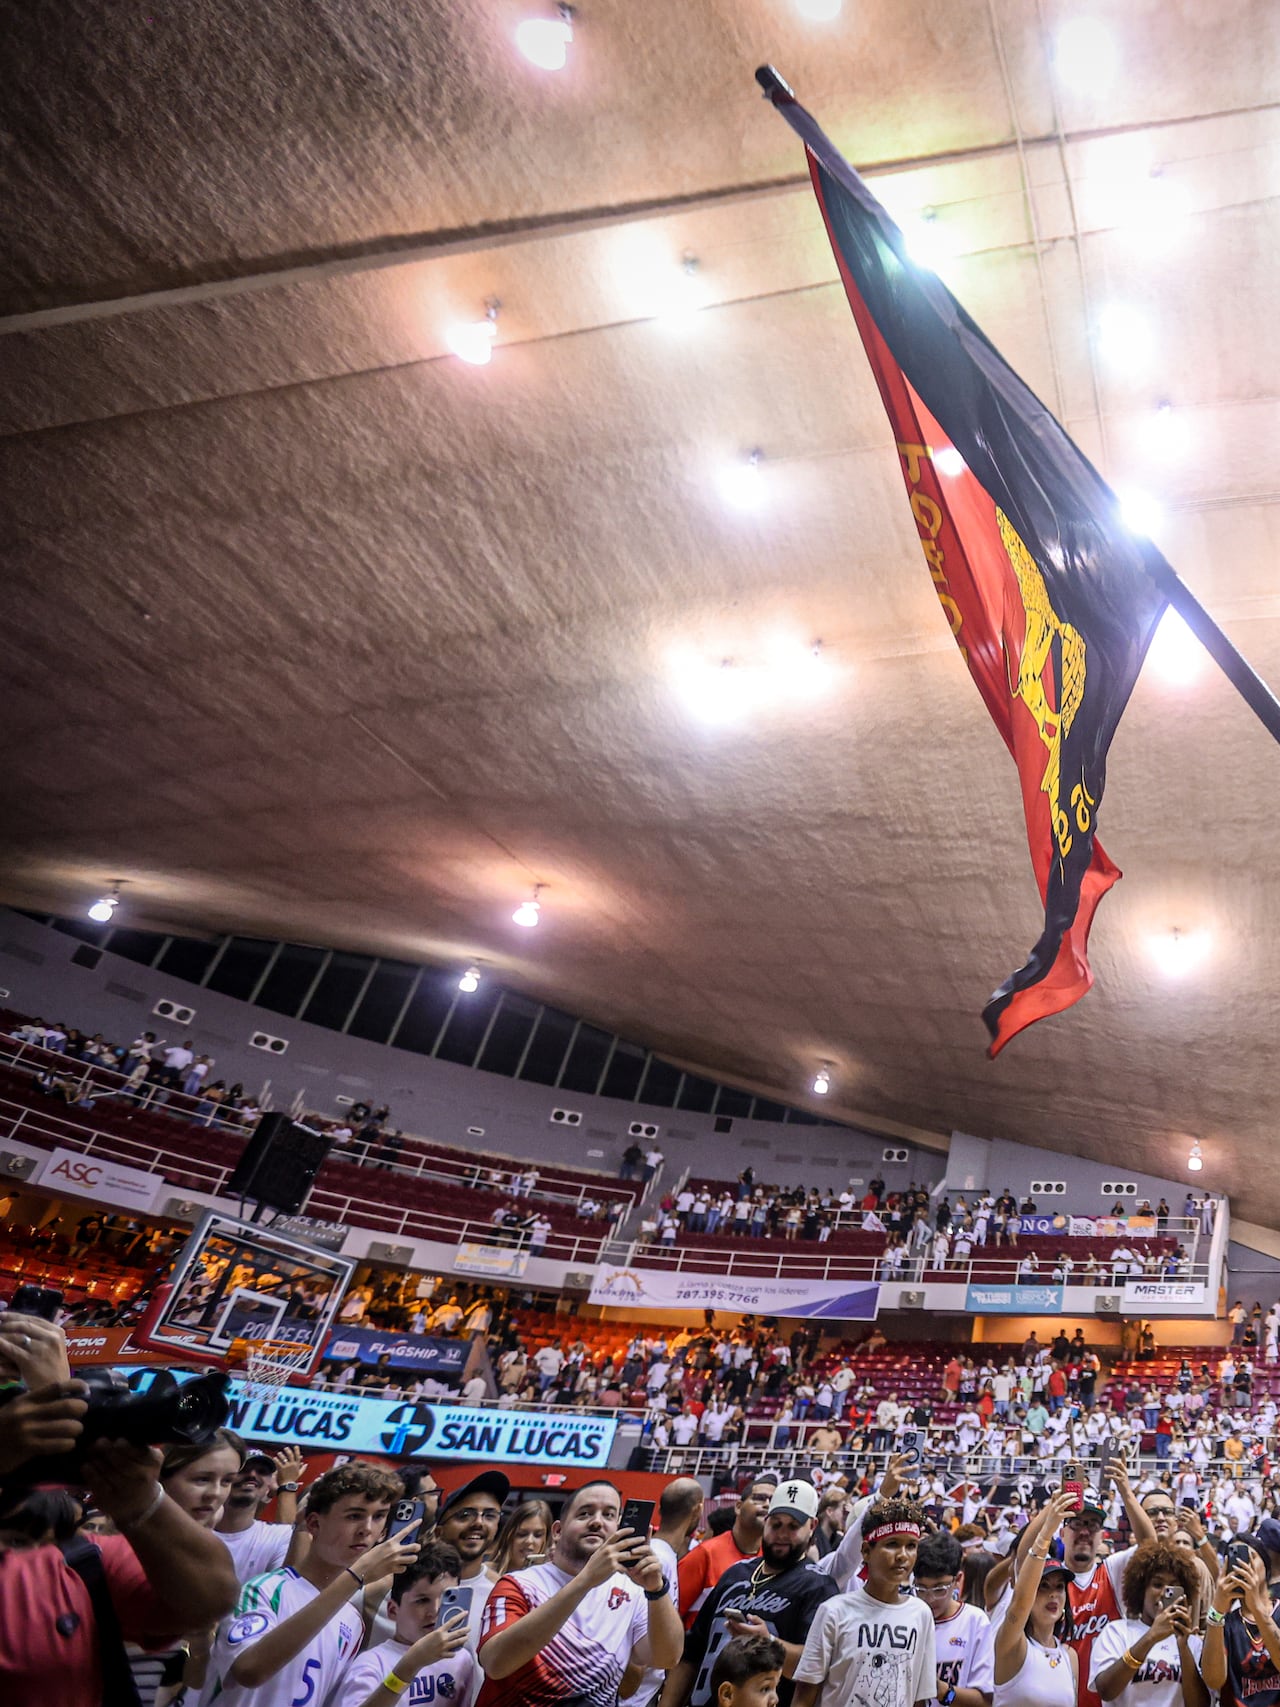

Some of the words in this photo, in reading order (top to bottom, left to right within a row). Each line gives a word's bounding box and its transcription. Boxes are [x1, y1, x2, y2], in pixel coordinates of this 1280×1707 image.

[51, 1160, 103, 1185] ASC
[315, 1218, 348, 1235] PLAZA
[1037, 1219, 1050, 1233] Q
[676, 1289, 759, 1304] 787.395.7766
[1134, 1285, 1196, 1295] MASTER
[369, 1342, 438, 1360] FLAGSHIP
[303, 1398, 360, 1412] EPISCOPAL
[252, 1402, 355, 1441] LUCAS
[445, 1413, 490, 1424] SISTEMA
[495, 1417, 508, 1425] DE
[513, 1418, 546, 1428] SALUD
[551, 1421, 606, 1433] EPISCOPAL
[436, 1422, 501, 1453] SAN
[505, 1427, 603, 1460] LUCAS
[876, 1523, 893, 1537] LEONES
[857, 1623, 918, 1655] NASA
[291, 1658, 322, 1707] 5
